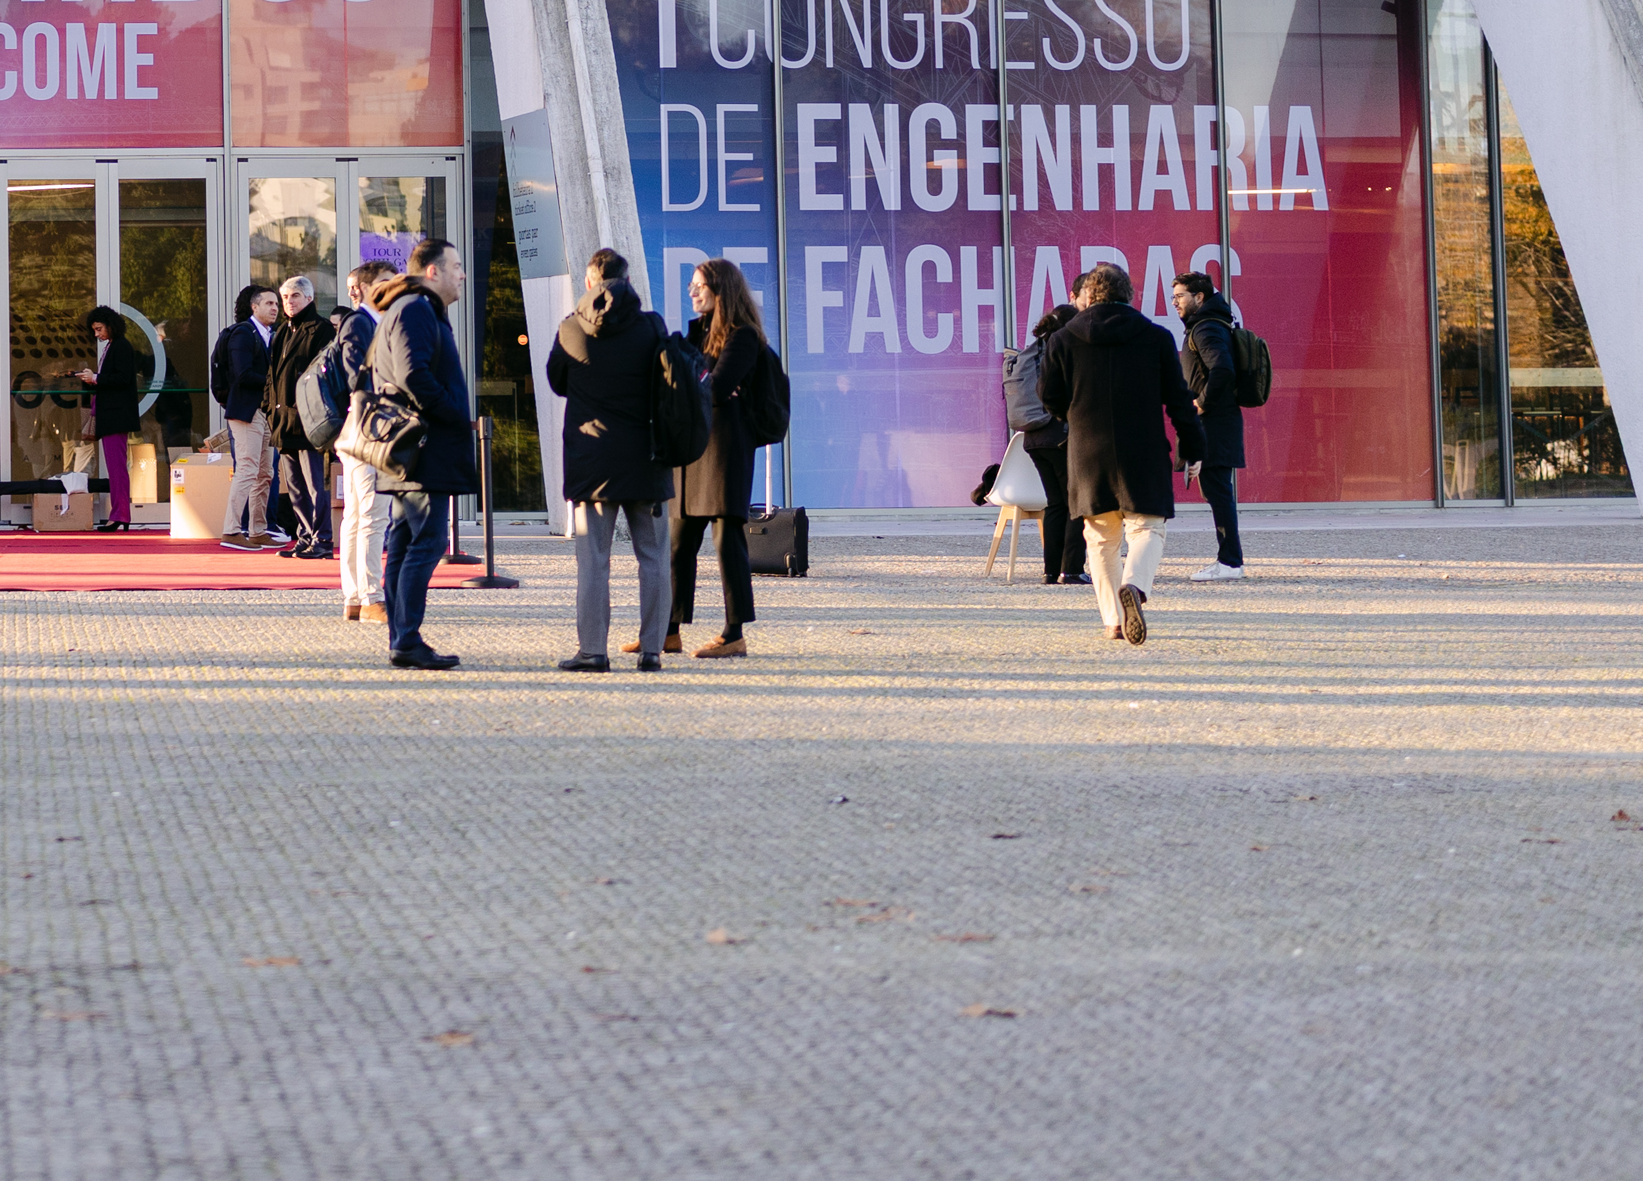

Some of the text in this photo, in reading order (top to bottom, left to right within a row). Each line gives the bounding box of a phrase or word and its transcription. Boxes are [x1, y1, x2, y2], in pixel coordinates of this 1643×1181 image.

[660, 102, 1330, 212] DE ENGENHARIA
[373, 248, 401, 257] TOUR
